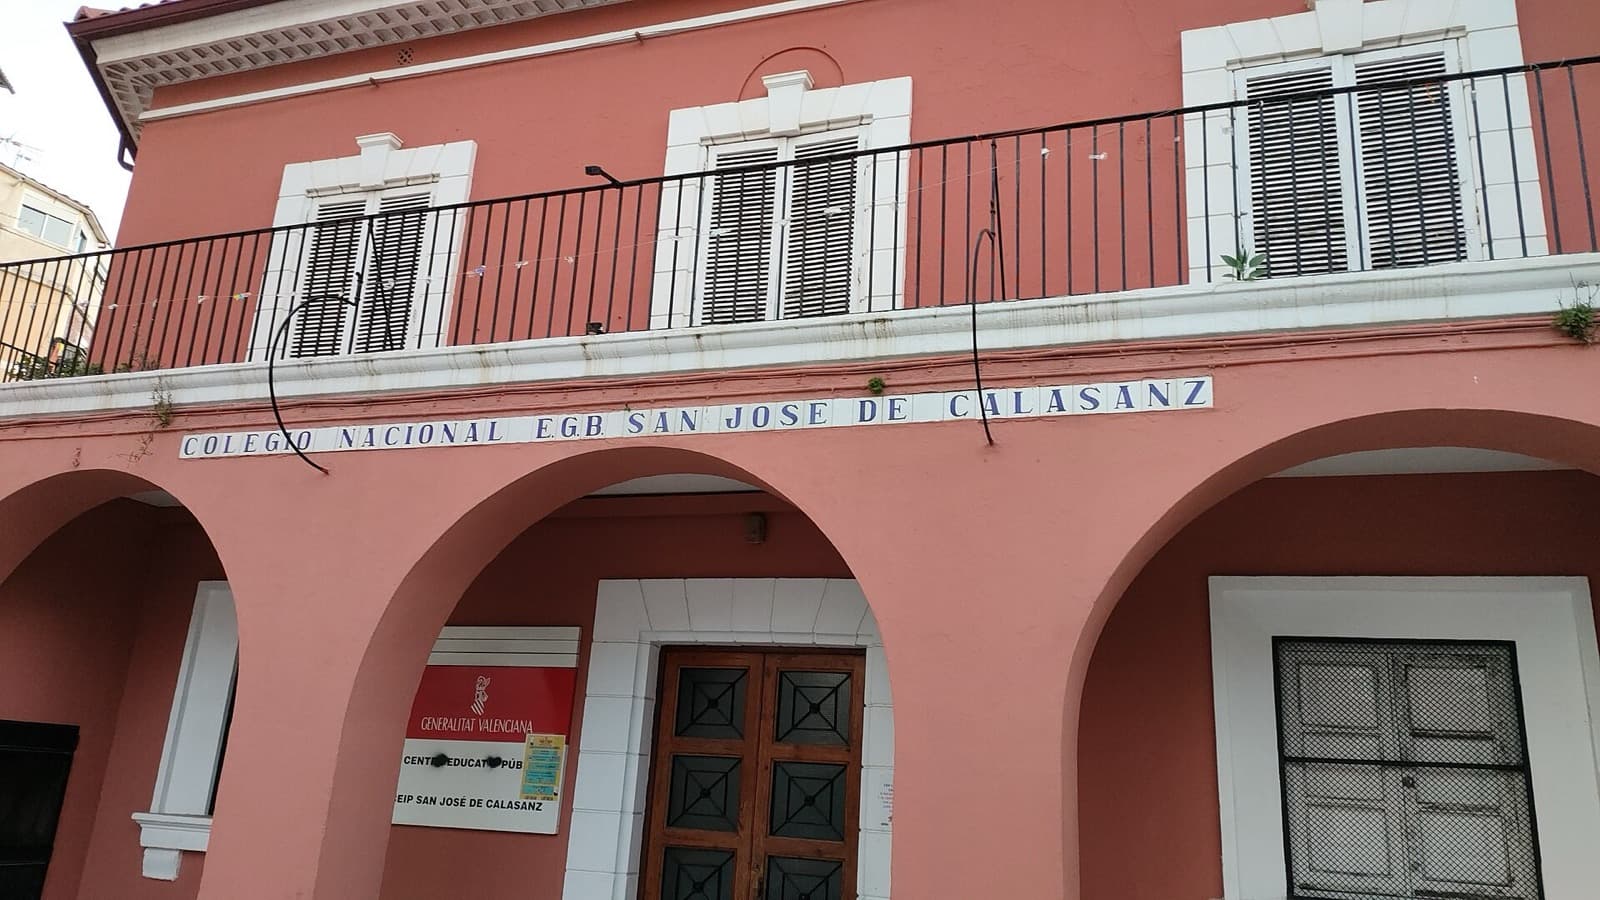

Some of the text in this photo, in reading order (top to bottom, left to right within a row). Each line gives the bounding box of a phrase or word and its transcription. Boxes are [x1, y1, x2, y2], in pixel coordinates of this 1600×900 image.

[184, 430, 312, 456] COLEGIO
[338, 421, 504, 448] NACIONAL
[627, 409, 698, 434] SAN
[725, 402, 828, 430] JOSE
[858, 398, 908, 423] DE
[949, 380, 1207, 418] CALASANZ
[421, 716, 534, 734] GENERALITAT VALENCIANA
[403, 755, 523, 770] CENT EDUCAT PÚB
[395, 794, 543, 812] EIP SAN JOSÉ DE CALASANZ
